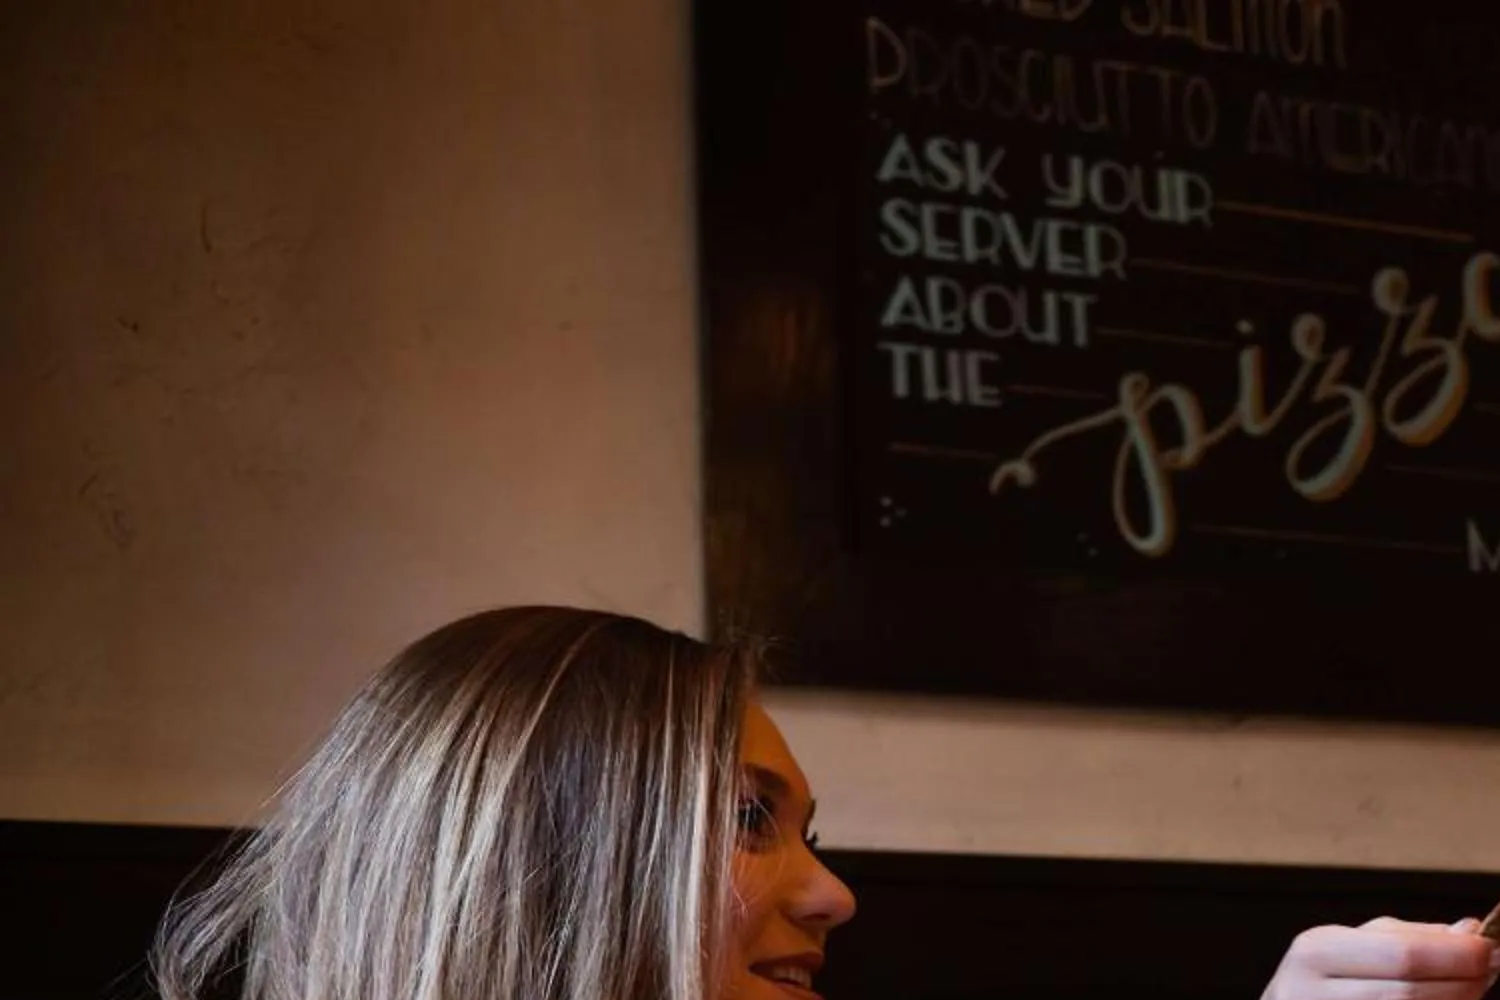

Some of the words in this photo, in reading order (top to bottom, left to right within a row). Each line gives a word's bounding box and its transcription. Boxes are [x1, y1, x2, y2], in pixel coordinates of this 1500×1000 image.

[874, 131, 1009, 200] ASK
[1040, 153, 1215, 228] YOUR
[877, 196, 1129, 282] SERVER
[879, 273, 1099, 349] ABOUT
[876, 340, 1004, 408] THE
